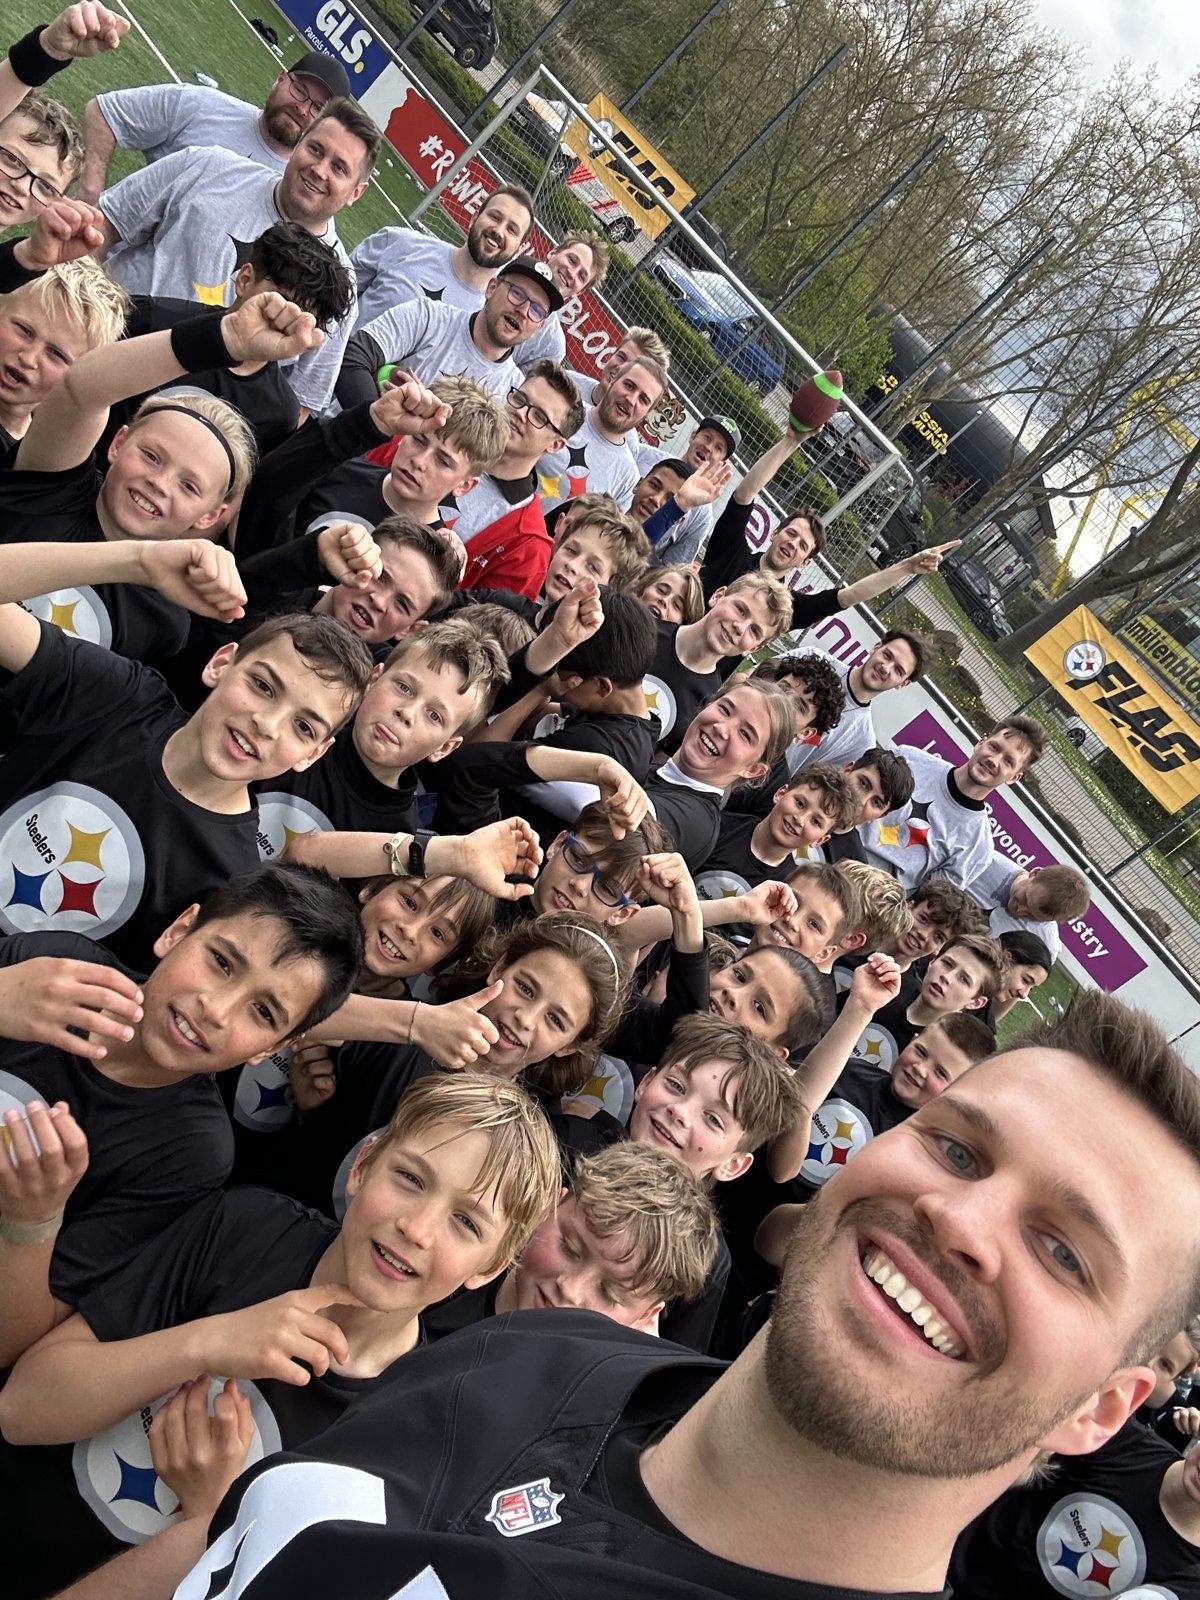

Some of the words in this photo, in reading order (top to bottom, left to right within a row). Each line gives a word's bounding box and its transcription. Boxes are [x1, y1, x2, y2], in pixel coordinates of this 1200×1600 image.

[304, 26, 325, 51] Parcels
[1125, 618, 1200, 702] milienblo
[1065, 660, 1200, 773] FLAG
[25, 813, 56, 865] Steelers
[255, 832, 275, 856] elers
[1067, 916, 1110, 959] istry
[812, 1113, 830, 1139] Steelers
[501, 1490, 531, 1529] NFL
[1069, 1509, 1091, 1548] Steelers
